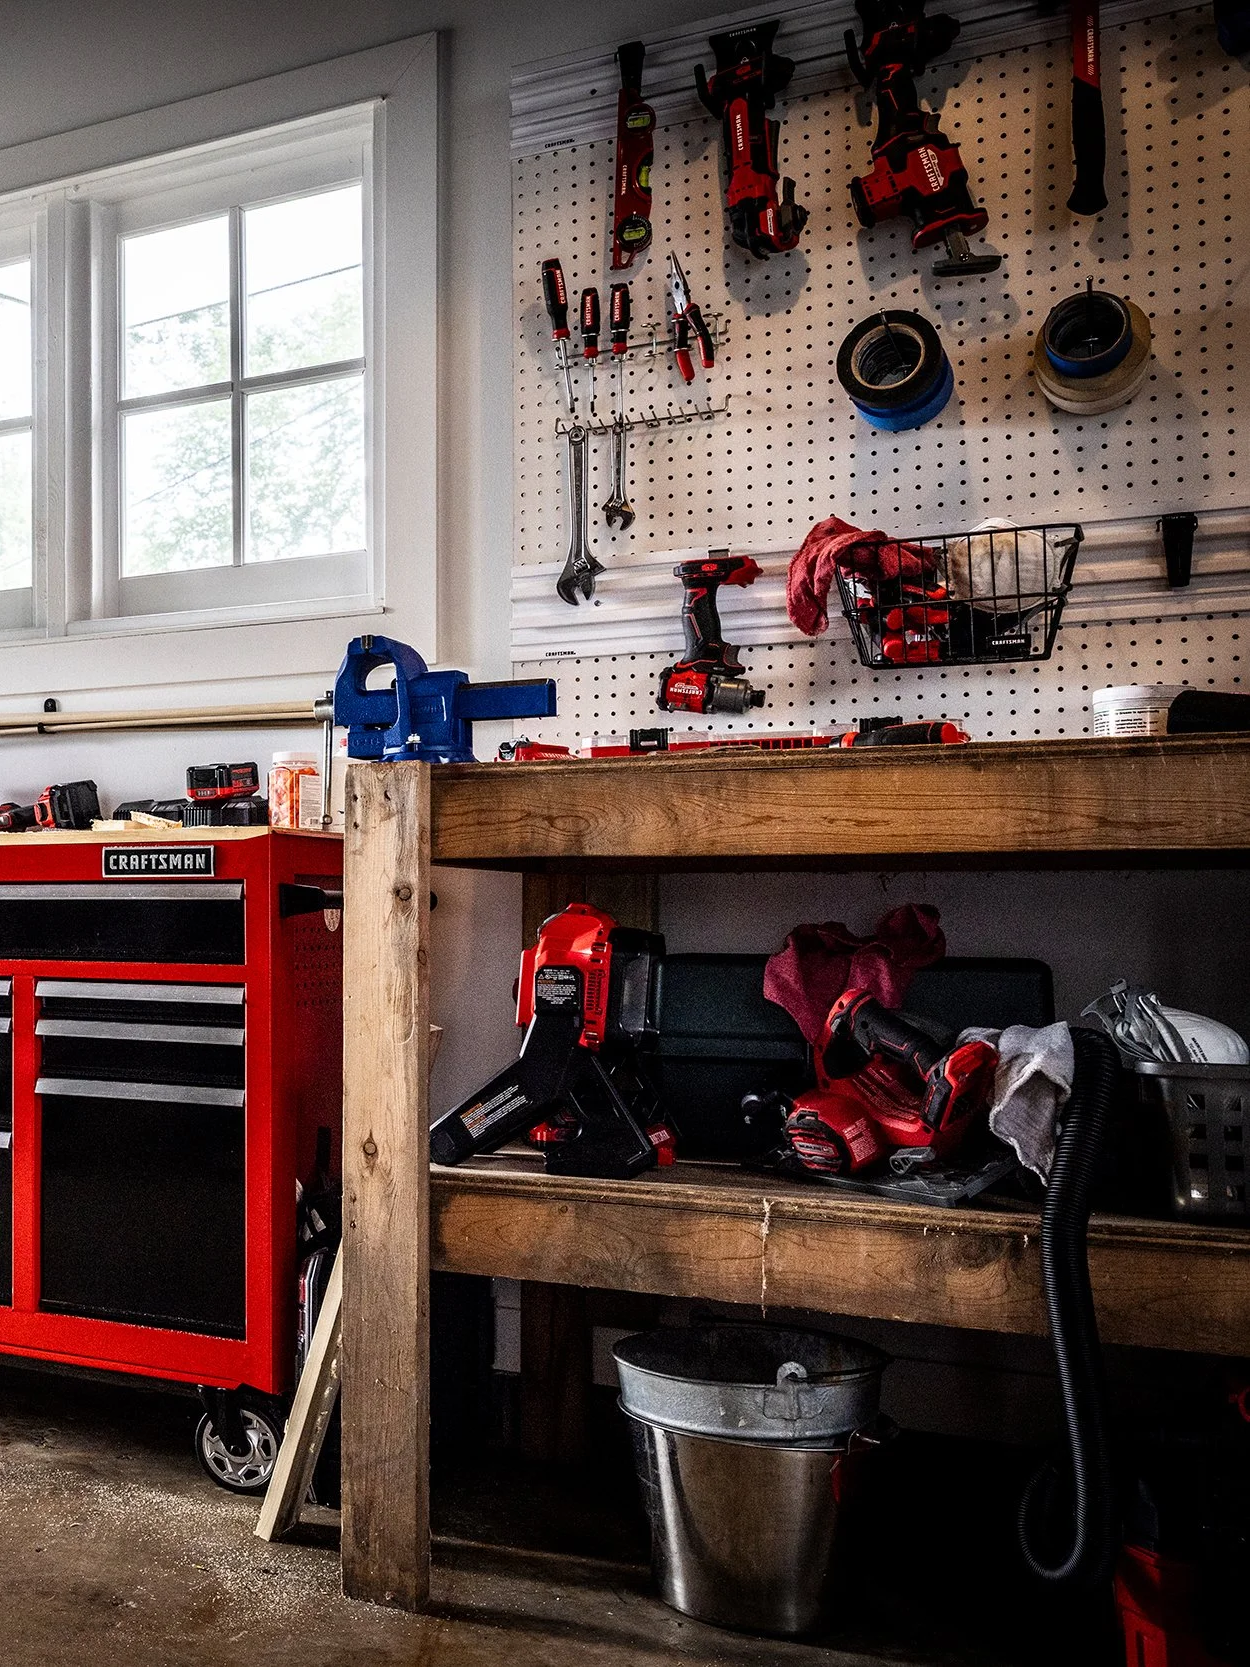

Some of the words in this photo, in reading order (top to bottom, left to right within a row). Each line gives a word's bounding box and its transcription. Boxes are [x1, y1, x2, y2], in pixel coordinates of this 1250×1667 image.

[735, 113, 743, 151] CRAFTSMAN
[917, 146, 940, 192] CRAFTSMAN
[555, 269, 566, 304] CRAFTSMAN
[669, 687, 703, 696] CRAFTSMAN
[109, 853, 206, 870] CRAFTSMAN
